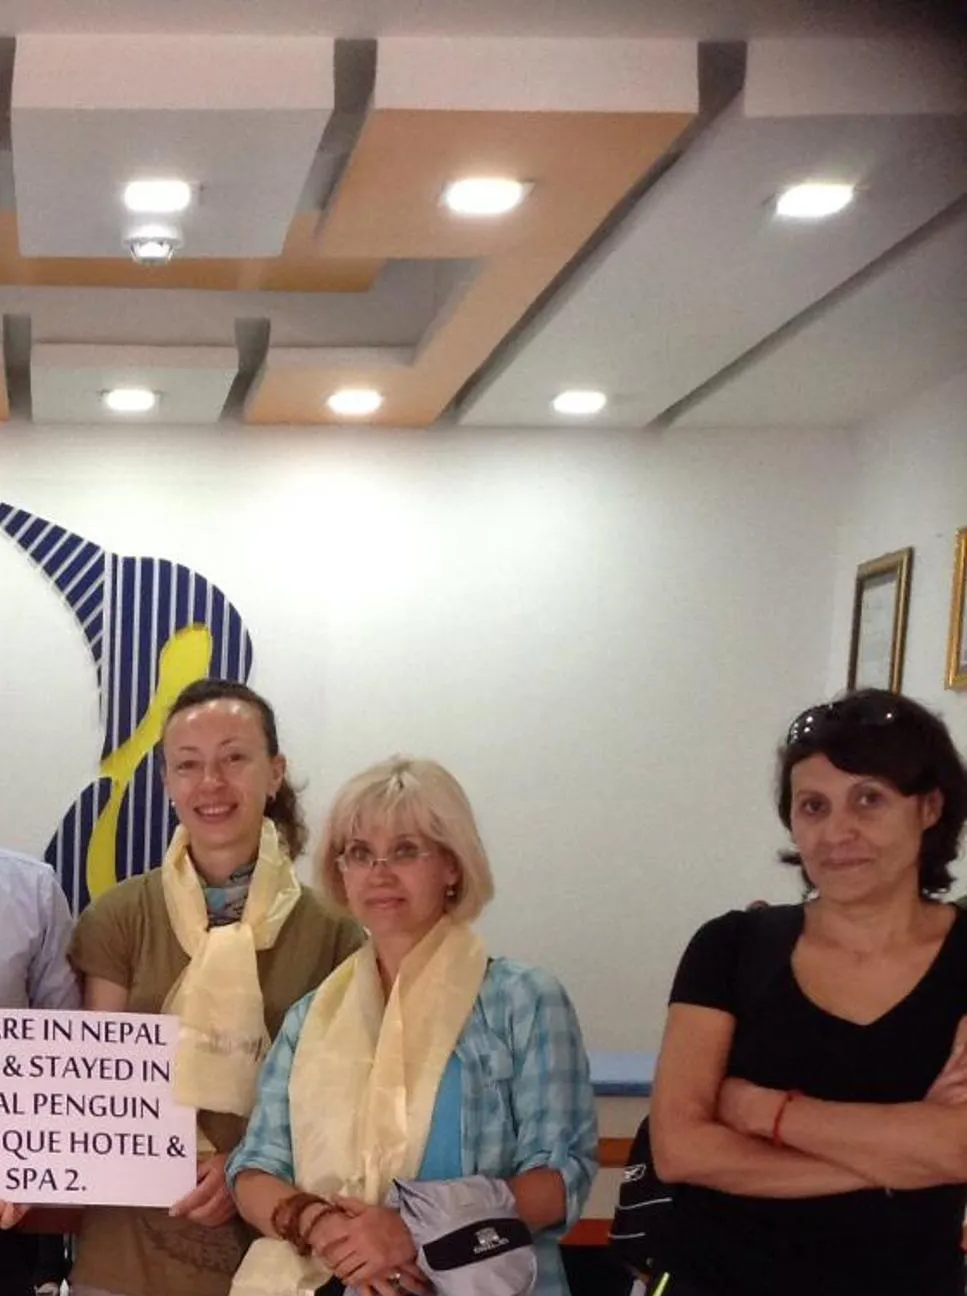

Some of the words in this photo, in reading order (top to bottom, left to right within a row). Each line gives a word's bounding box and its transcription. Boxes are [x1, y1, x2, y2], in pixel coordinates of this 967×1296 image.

[43, 1018, 73, 1042] IN
[81, 1020, 167, 1047] NEPAL
[2, 1054, 24, 1078] &
[29, 1055, 134, 1081] STAYED
[142, 1059, 170, 1083] IN
[33, 1092, 160, 1120] PENGUIN
[70, 1131, 160, 1157] HOTEL
[166, 1134, 187, 1159] &
[5, 1167, 58, 1191] SPA
[64, 1168, 87, 1192] 2.
